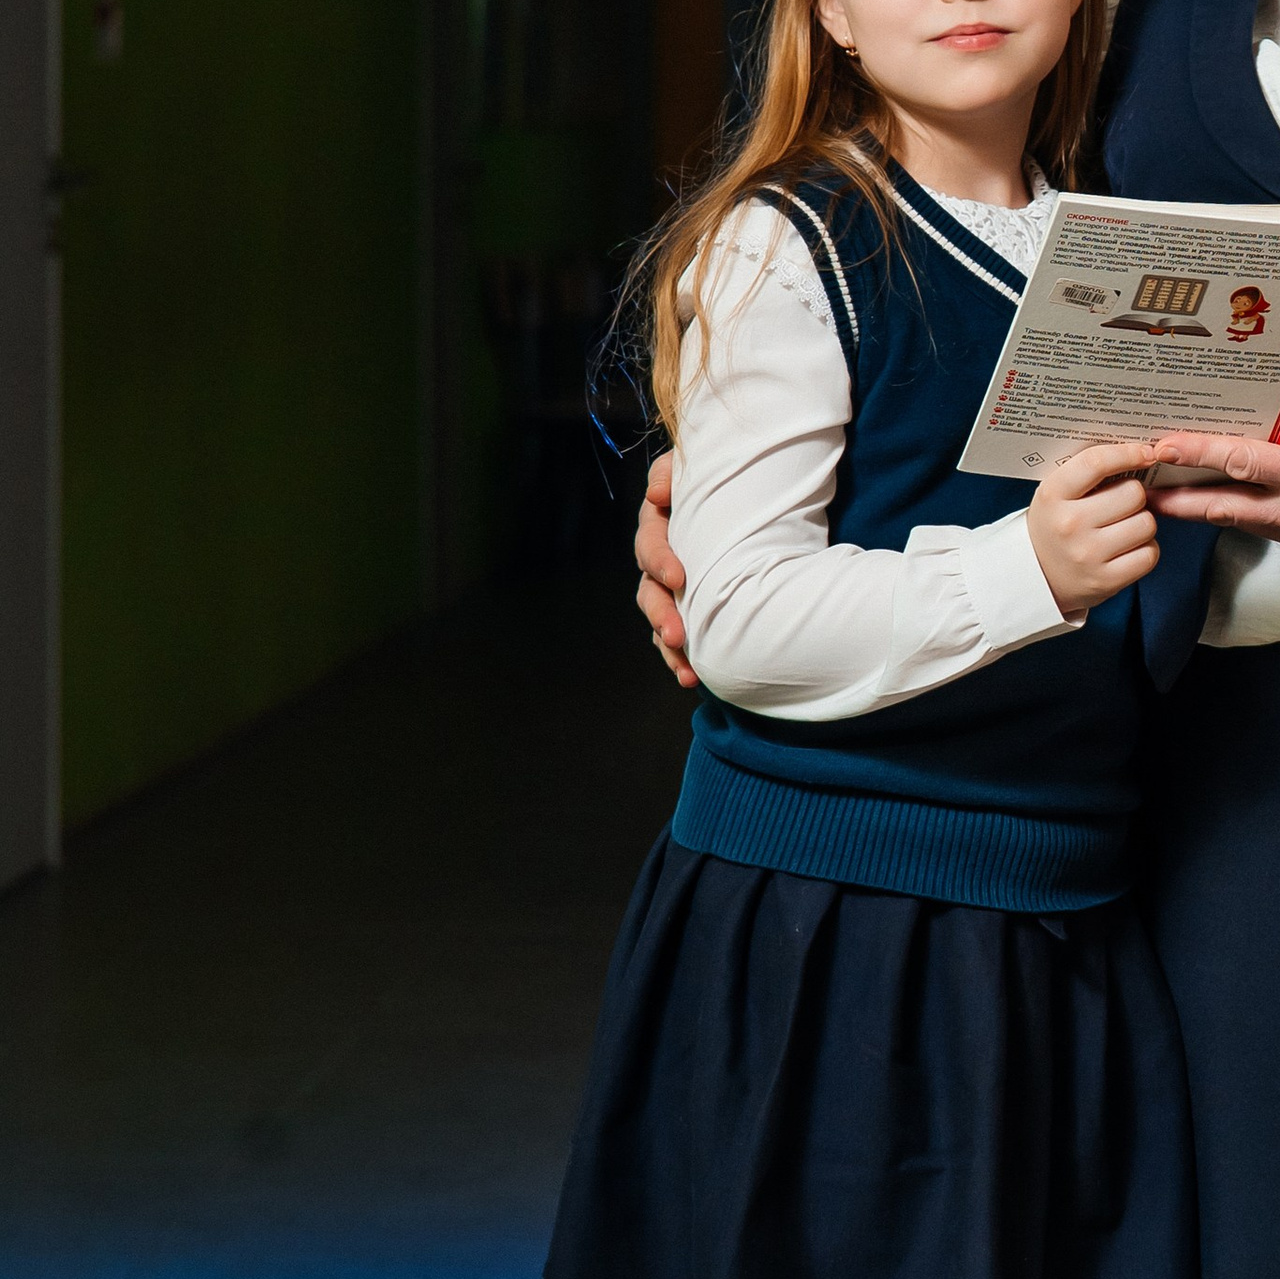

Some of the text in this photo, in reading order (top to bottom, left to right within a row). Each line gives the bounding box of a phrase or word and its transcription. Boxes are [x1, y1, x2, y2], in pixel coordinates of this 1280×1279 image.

[1066, 214, 1130, 226] СКОРОЧТЕНИЕ
[1074, 222, 1109, 231] которого
[1081, 235, 1119, 244] большой
[1064, 332, 1089, 340] более
[1053, 350, 1083, 359] Школы
[1018, 371, 1035, 379] Шаг
